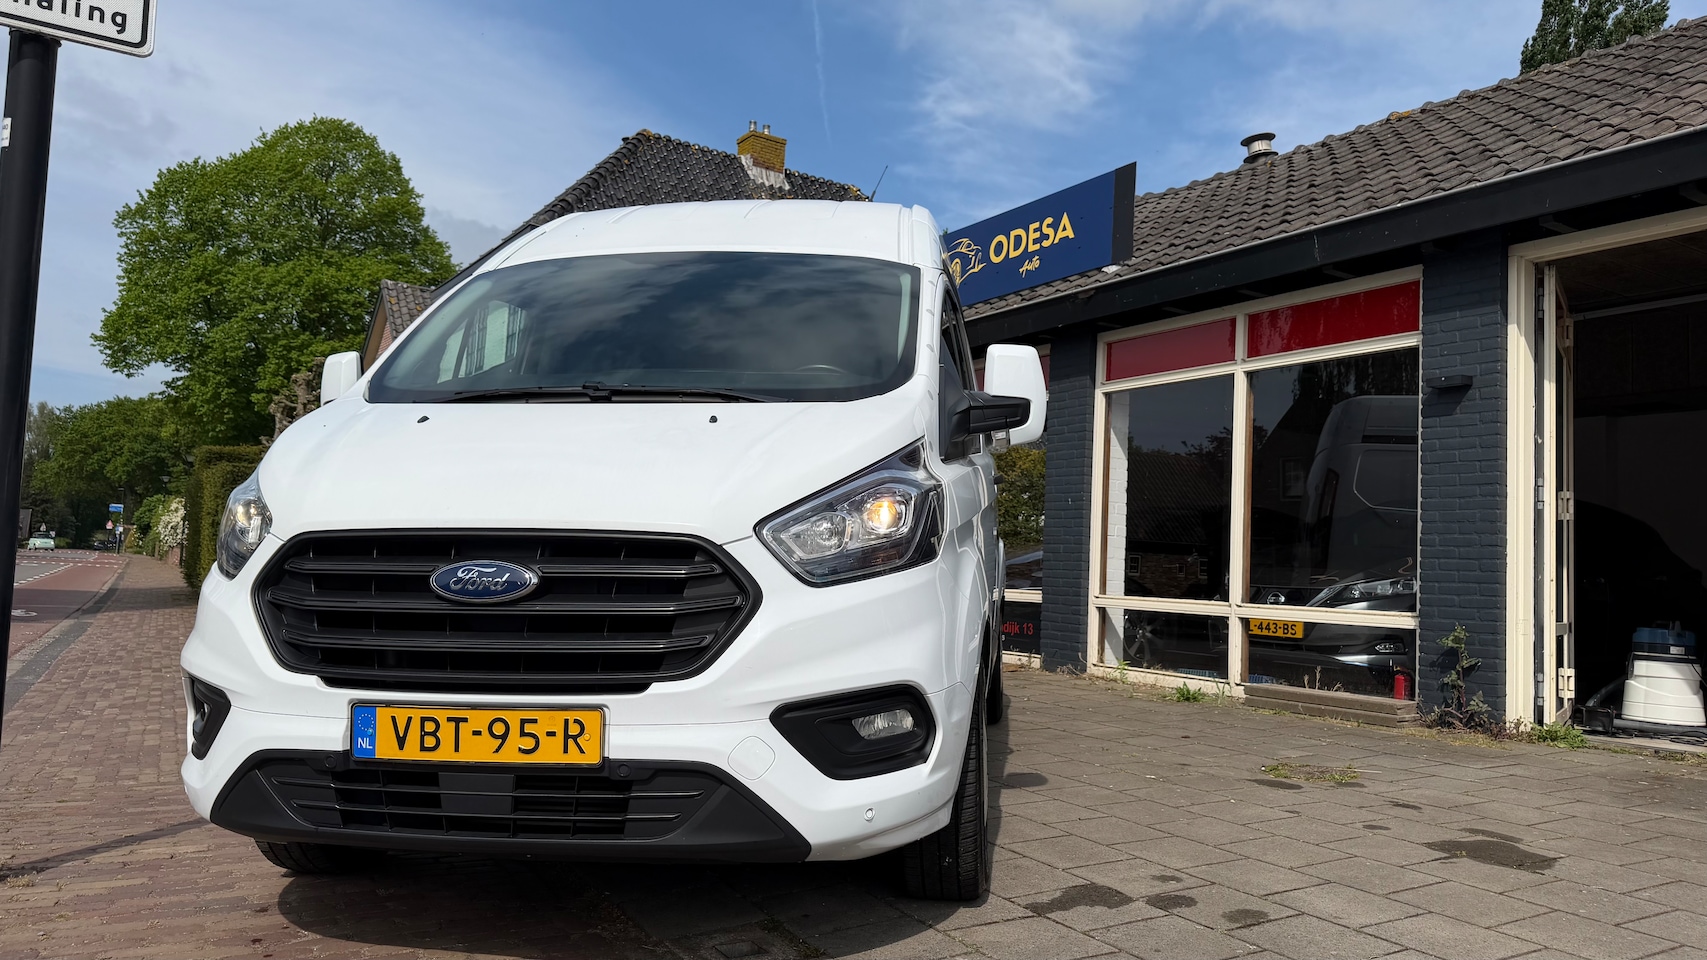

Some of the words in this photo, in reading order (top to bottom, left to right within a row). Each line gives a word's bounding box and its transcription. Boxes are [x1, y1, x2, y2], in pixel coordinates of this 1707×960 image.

[12, 0, 127, 34] aling
[989, 211, 1075, 264] ODESA
[1019, 255, 1040, 278] Auto
[449, 566, 511, 591] Ford
[1022, 622, 1034, 635] 13
[357, 737, 373, 749] NL
[390, 715, 587, 755] VBT-95-R
